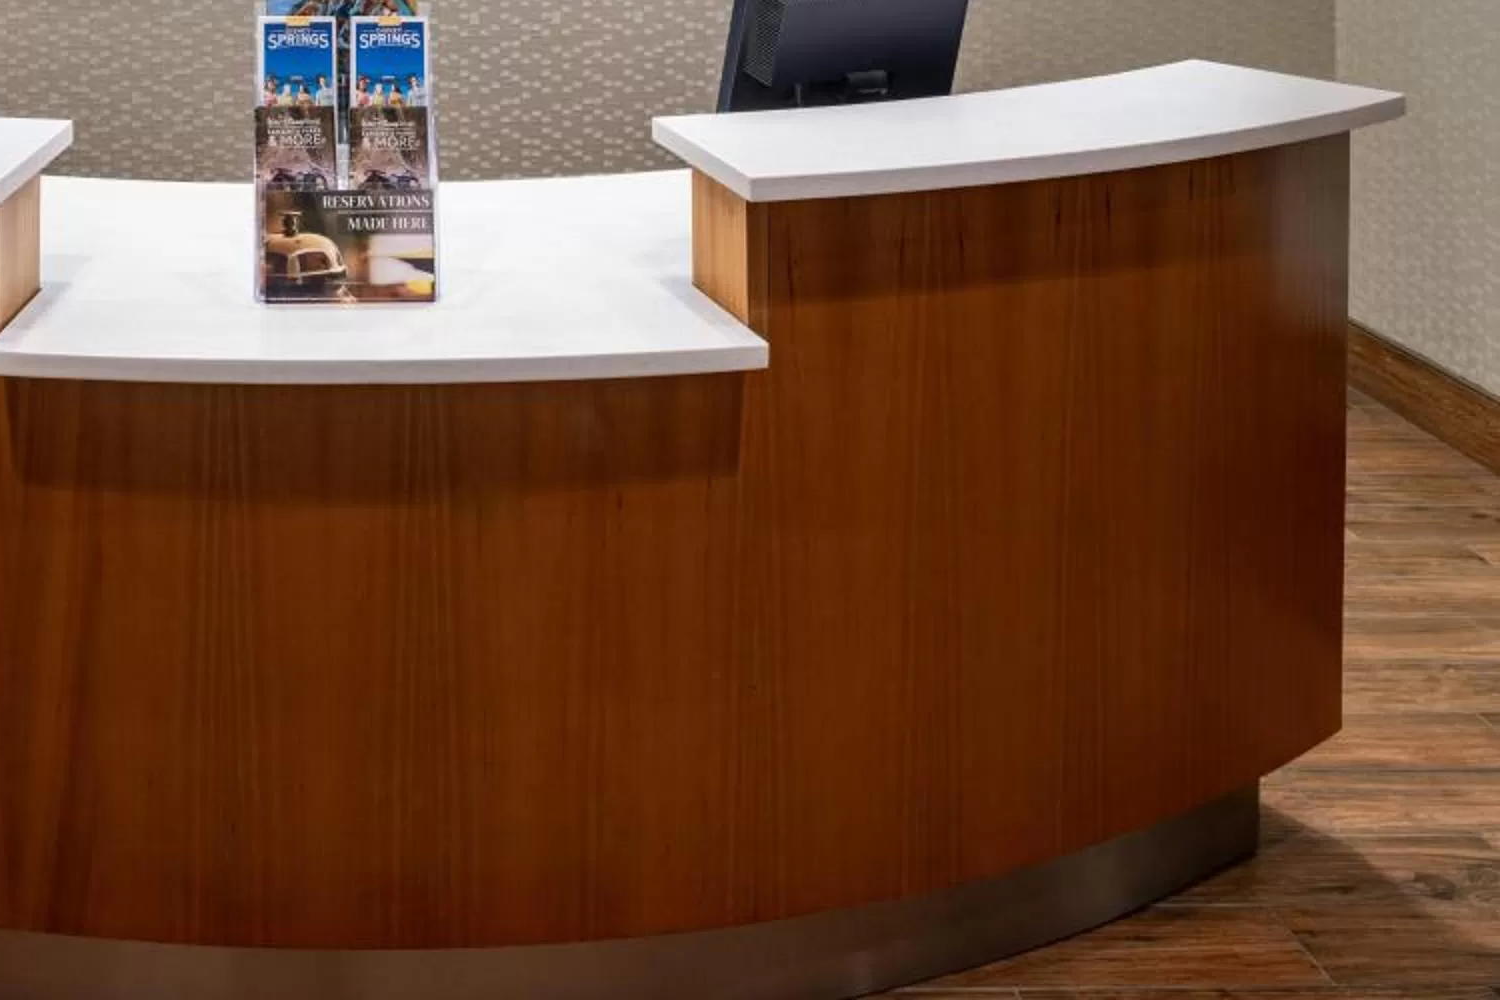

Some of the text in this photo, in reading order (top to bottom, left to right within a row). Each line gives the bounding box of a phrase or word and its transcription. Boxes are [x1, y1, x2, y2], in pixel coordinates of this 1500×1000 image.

[267, 33, 329, 49] SPRINGS
[359, 33, 421, 49] SPRINGS
[322, 194, 430, 209] RESERVATIONS
[348, 216, 428, 230] MADE HERE
